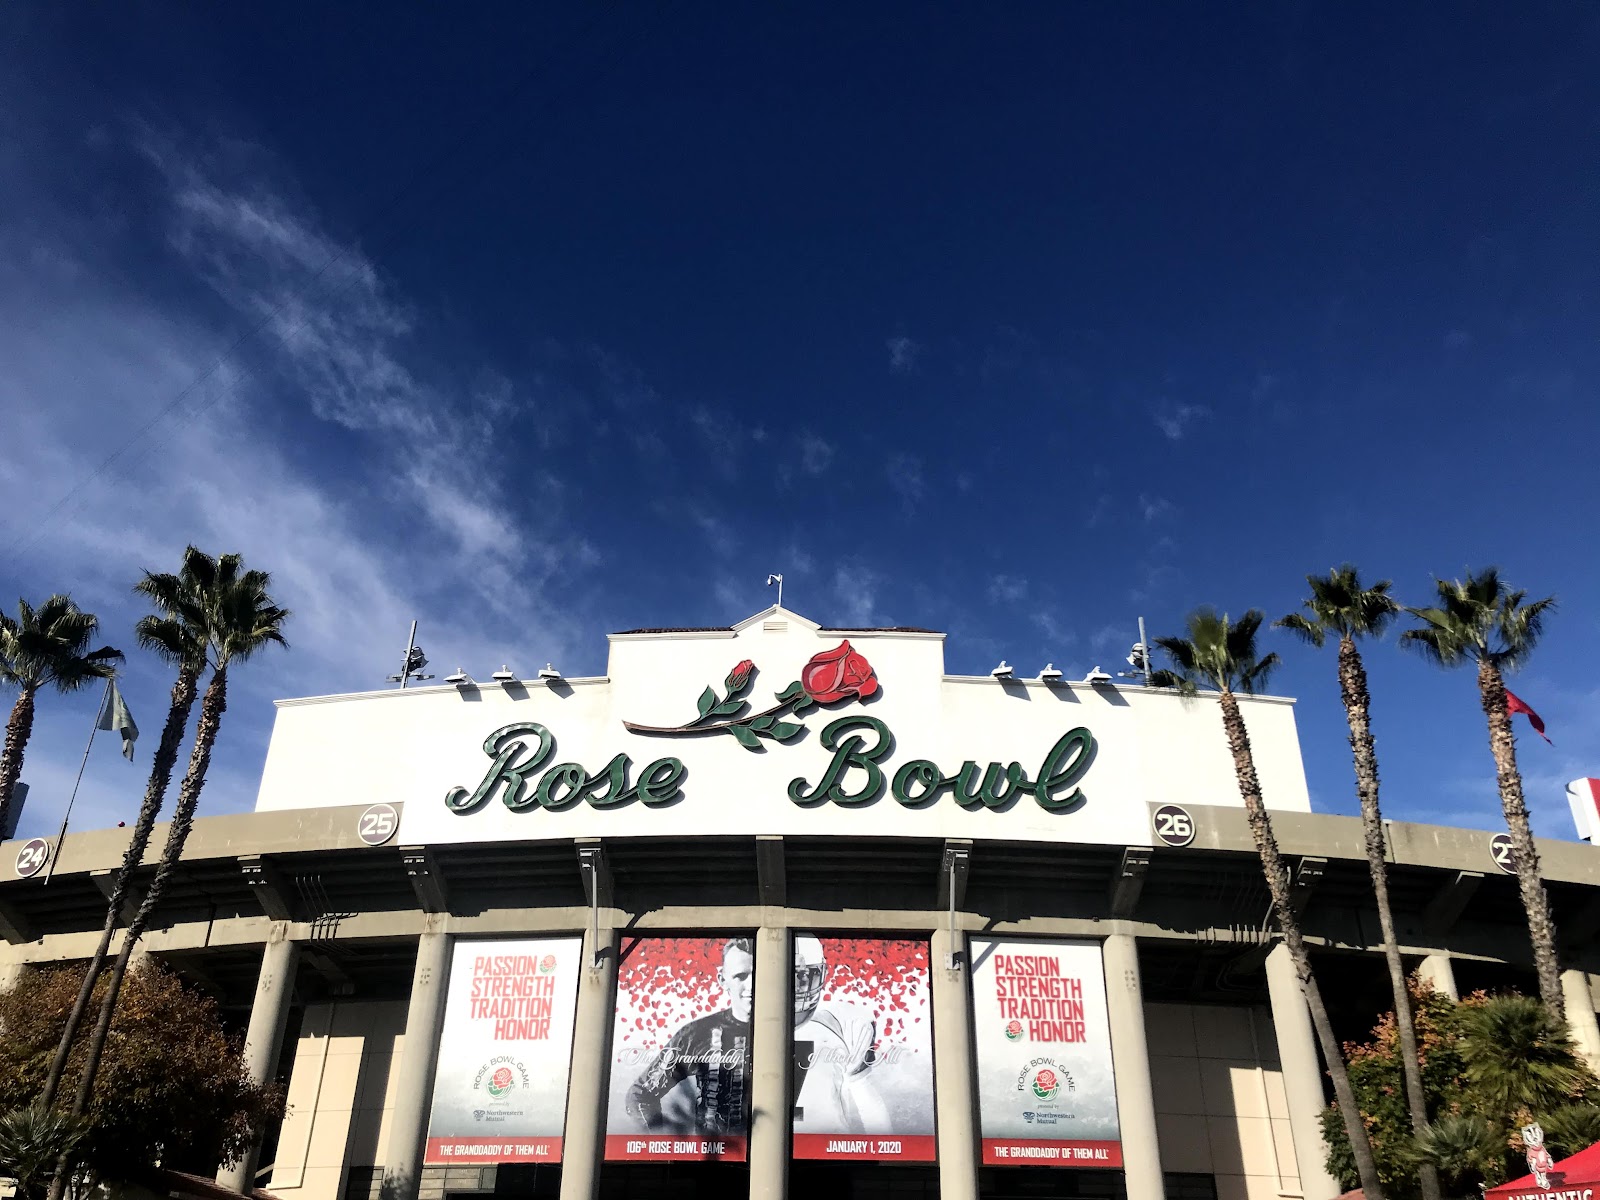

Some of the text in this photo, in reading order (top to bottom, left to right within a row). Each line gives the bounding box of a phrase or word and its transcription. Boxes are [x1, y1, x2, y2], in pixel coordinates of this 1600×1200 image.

[445, 715, 1096, 815] Rose Bowl
[361, 813, 394, 836] 25
[1156, 813, 1191, 837] 26
[17, 846, 45, 869] 24
[1493, 842, 1514, 864] 2
[474, 955, 537, 976] PASSION
[994, 954, 1060, 977] PASSION
[471, 976, 555, 998] STRENGTH
[995, 976, 1082, 999] STRENGTH
[471, 997, 553, 1019] TRADITION
[997, 997, 1084, 1021] TRADITION
[494, 1018, 551, 1041] HONOR
[1029, 1020, 1086, 1043] HONOR
[660, 1046, 745, 1070] Granddaddy
[473, 1055, 530, 1090] ROSE BOWL GAME
[1017, 1057, 1076, 1092] ROSE BOWL GAME
[440, 1144, 453, 1156] THE
[454, 1144, 503, 1156] GRANDDADDY
[503, 1144, 514, 1156] OF
[515, 1144, 534, 1155] THEM
[648, 1141, 672, 1154] ROSE
[673, 1141, 699, 1154] BOWL
[701, 1141, 726, 1155] GAME
[826, 1140, 902, 1155] JANUARY 1, 2020
[994, 1146, 1009, 1157] THE
[1010, 1146, 1060, 1158] GRANDDADDY
[1061, 1147, 1072, 1159] OF
[1073, 1148, 1093, 1159] THEM
[1508, 1188, 1593, 1200] ENTIC
